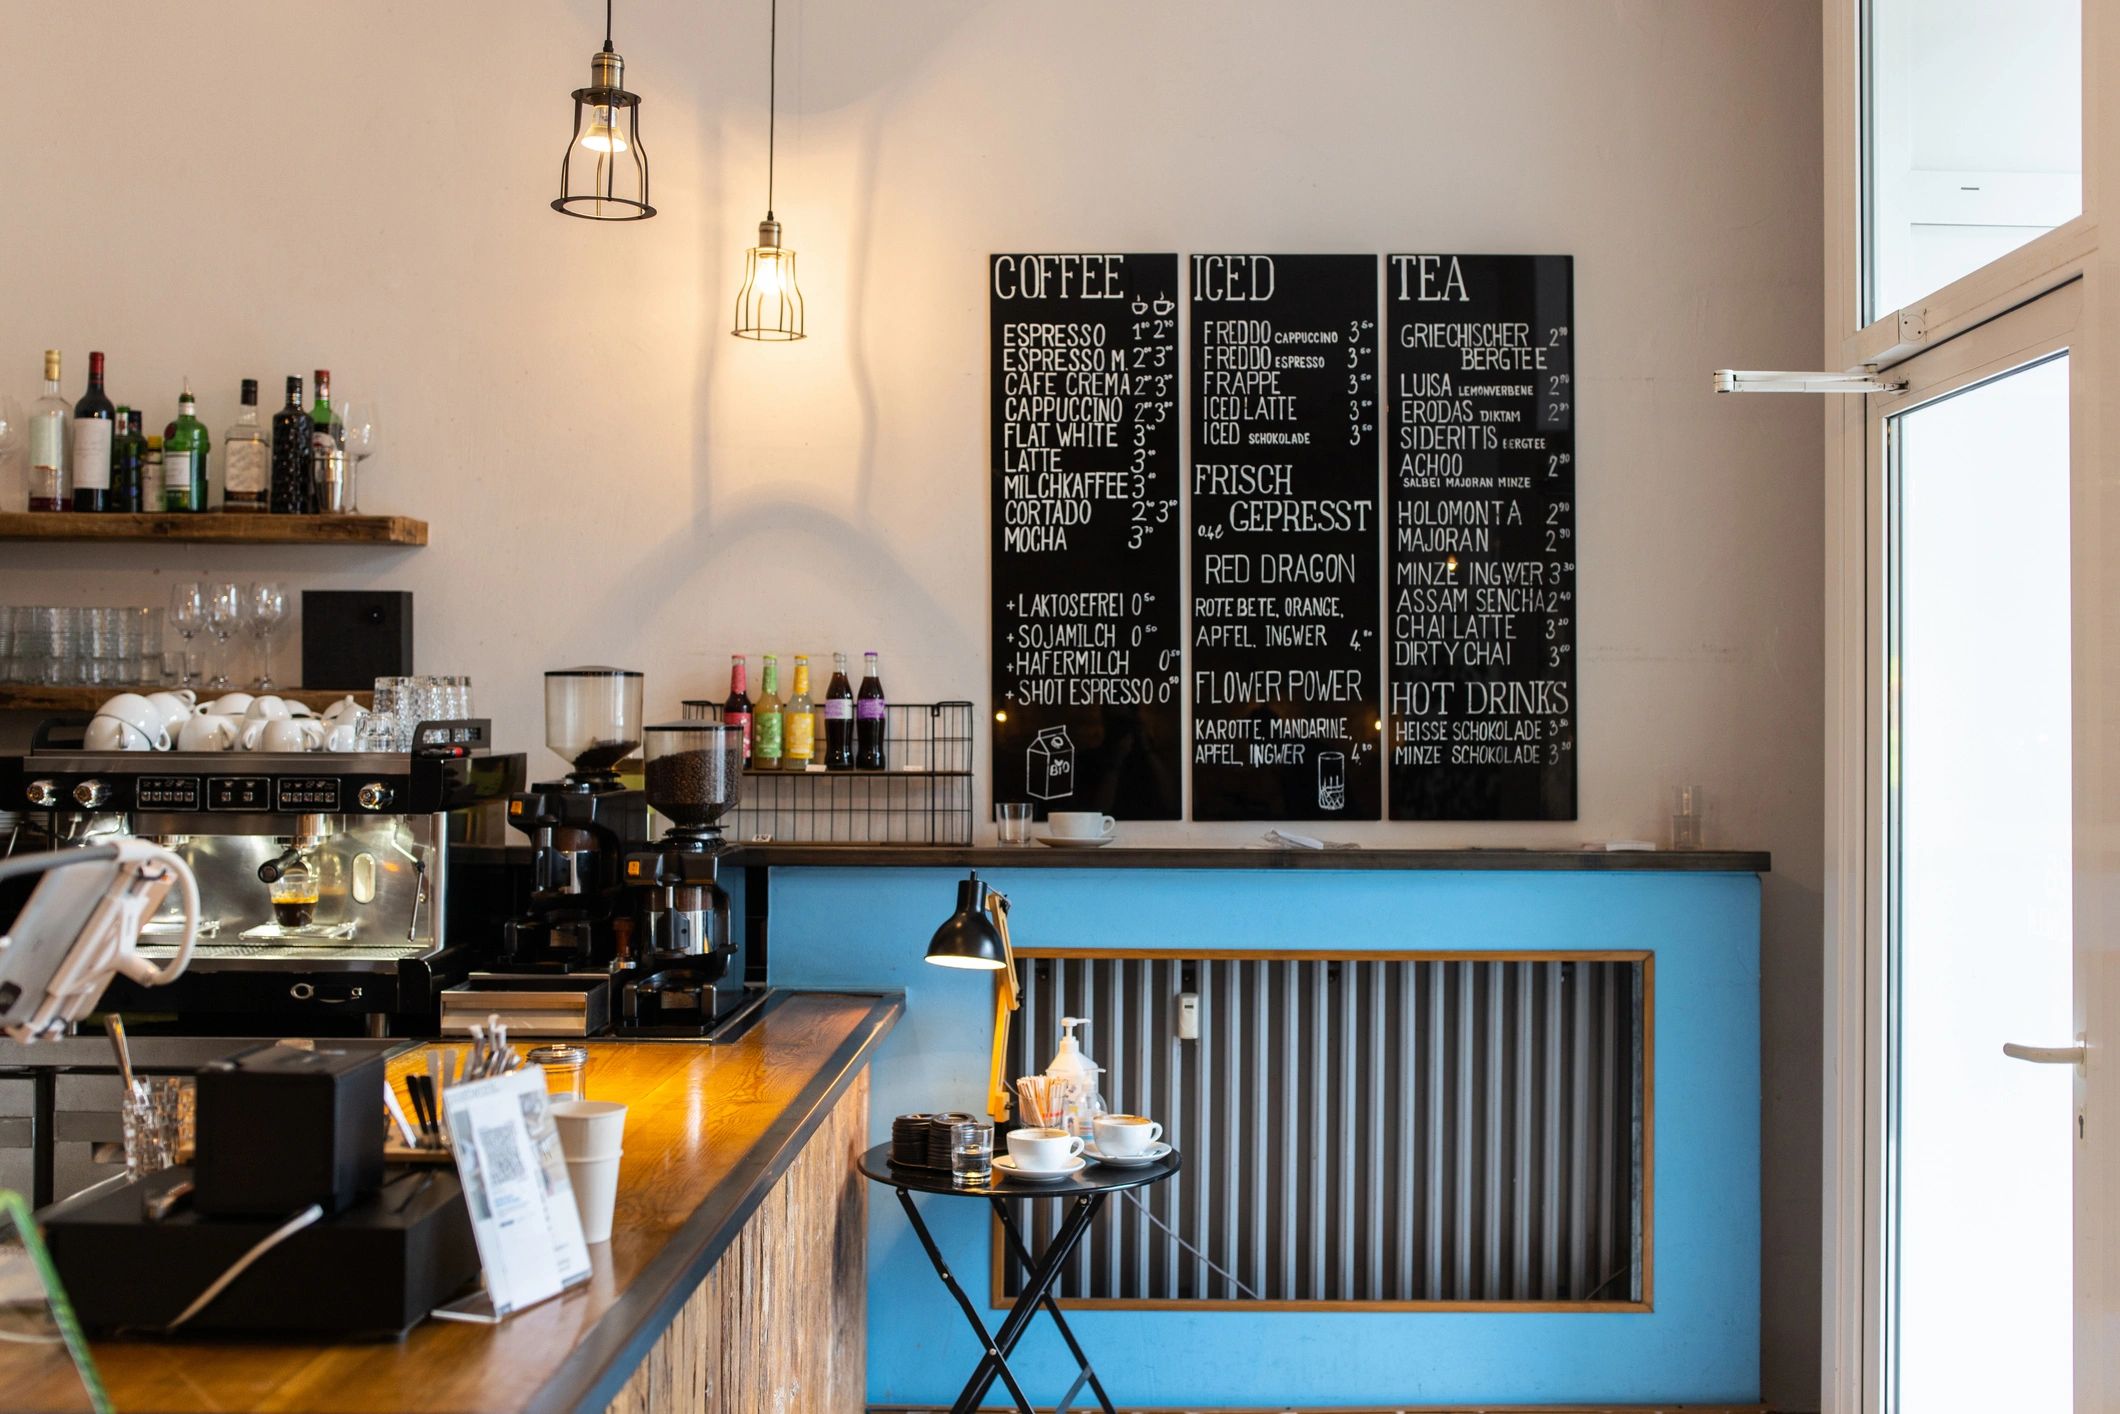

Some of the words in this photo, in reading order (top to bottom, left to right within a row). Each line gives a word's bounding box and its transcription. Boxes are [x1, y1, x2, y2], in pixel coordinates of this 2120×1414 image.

[995, 255, 1124, 299] COFFEE
[1193, 255, 1275, 301] ICED
[1392, 255, 1470, 301] TEA
[1004, 323, 1106, 347] ESPRESSO
[1204, 320, 1271, 344] FREDDO
[1274, 331, 1338, 344] CAPPUCCINO
[1401, 322, 1529, 348] GRIECHISCHER
[1003, 348, 1105, 371] ESPRESSO
[1111, 350, 1129, 371] M.
[1204, 345, 1272, 370] FREDDO
[1275, 356, 1325, 369] ESPRESSO
[1460, 347, 1548, 370] BERGTEE
[1005, 372, 1057, 395] CAFE
[1066, 372, 1131, 395] CREMA
[1204, 371, 1281, 395] FRAPPE
[1401, 373, 1452, 397] LUISA
[1458, 385, 1534, 397] LEMONVERBENE
[1005, 396, 1122, 422] CAPPUCCINO
[1204, 396, 1241, 420] ICED
[1244, 396, 1297, 420] LATTE
[1402, 399, 1473, 423] ERODAS
[1479, 410, 1521, 422] DIKTAM
[1004, 422, 1051, 448] FLAT
[1056, 422, 1118, 447] WHITE
[1204, 421, 1241, 445] ICED
[1248, 432, 1311, 445] SCHOKOLADE
[1400, 425, 1498, 450] SIDERITIS
[1004, 448, 1062, 472] LATTE
[1400, 453, 1463, 477] ACHOO
[1004, 472, 1129, 499] MILCHKAFFEE
[1194, 464, 1293, 495] FRISCH
[1403, 477, 1441, 488] SALBEI
[1446, 477, 1494, 488] MAJORAN
[1498, 477, 1531, 488] MINZE
[1005, 499, 1092, 525] CORTADO
[1229, 499, 1372, 532] GEPRESST
[1004, 525, 1067, 553] MOCHA
[1398, 527, 1489, 552] MAJORAN
[1205, 553, 1250, 584] RED
[1261, 553, 1355, 584] DRAGON
[1397, 562, 1459, 586] MINZE
[1469, 562, 1543, 586] INGWER
[1018, 593, 1123, 617] LAKTOSEFREI
[1195, 597, 1233, 617] ROTE
[1397, 588, 1467, 612] ASSAM
[1476, 588, 1545, 612] SENCHA
[1018, 623, 1115, 649] SOJAMILCH
[1265, 624, 1328, 647] INGWER
[1396, 614, 1445, 639] CHAI
[1453, 614, 1517, 639] LATTE
[1016, 650, 1129, 675] HAFERMILCH
[1395, 641, 1460, 666] DIRTY
[1464, 641, 1511, 666] CHAI
[1018, 679, 1064, 705] SHOT
[1069, 678, 1153, 704] ESPRESSO
[1196, 670, 1282, 704] FLOWER
[1289, 669, 1362, 702] POWER
[1391, 681, 1455, 715] HOT
[1465, 680, 1569, 715] DRINKS
[1395, 721, 1448, 742] HEISSE
[1453, 720, 1542, 741] SCHOKOLADE
[1250, 743, 1305, 768] INGWER
[1395, 746, 1443, 765] MINZE
[1451, 745, 1541, 765] SCHOKOLADE
